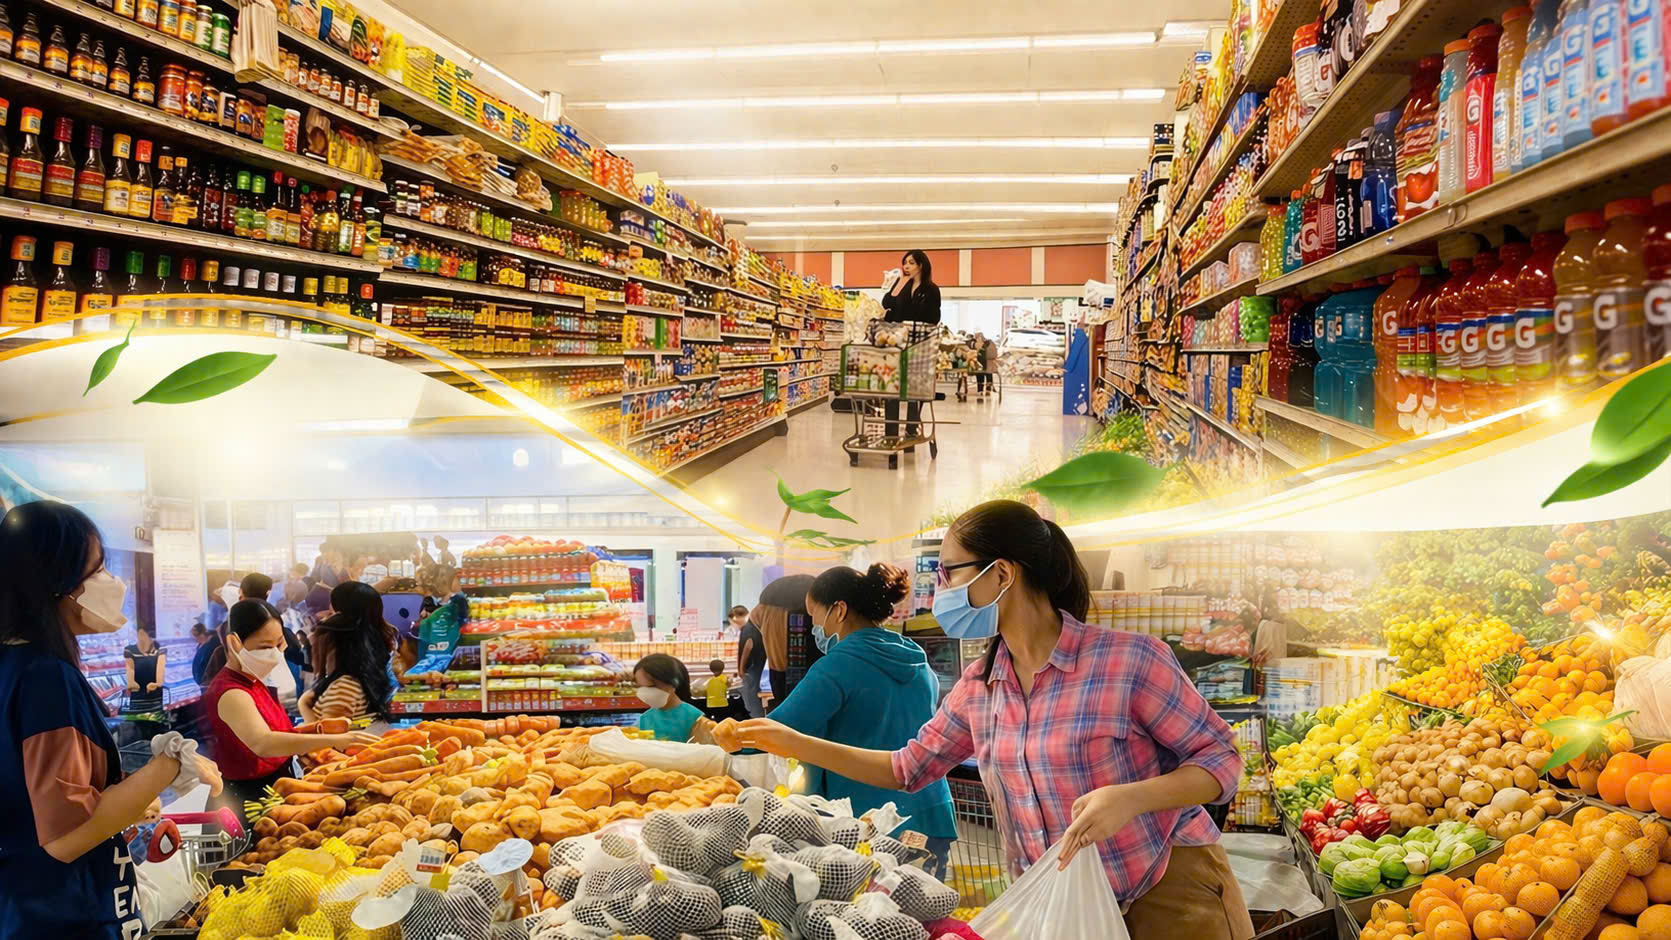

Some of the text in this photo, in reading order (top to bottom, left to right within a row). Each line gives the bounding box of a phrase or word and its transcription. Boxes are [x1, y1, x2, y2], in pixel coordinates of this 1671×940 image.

[1555, 302, 1573, 334] G
[1593, 295, 1616, 329] G
[1644, 287, 1671, 325] G
[1383, 311, 1397, 335] G
[1488, 324, 1505, 350] G
[1515, 318, 1536, 348] G
[1441, 330, 1456, 353] G
[1461, 326, 1479, 352] G
